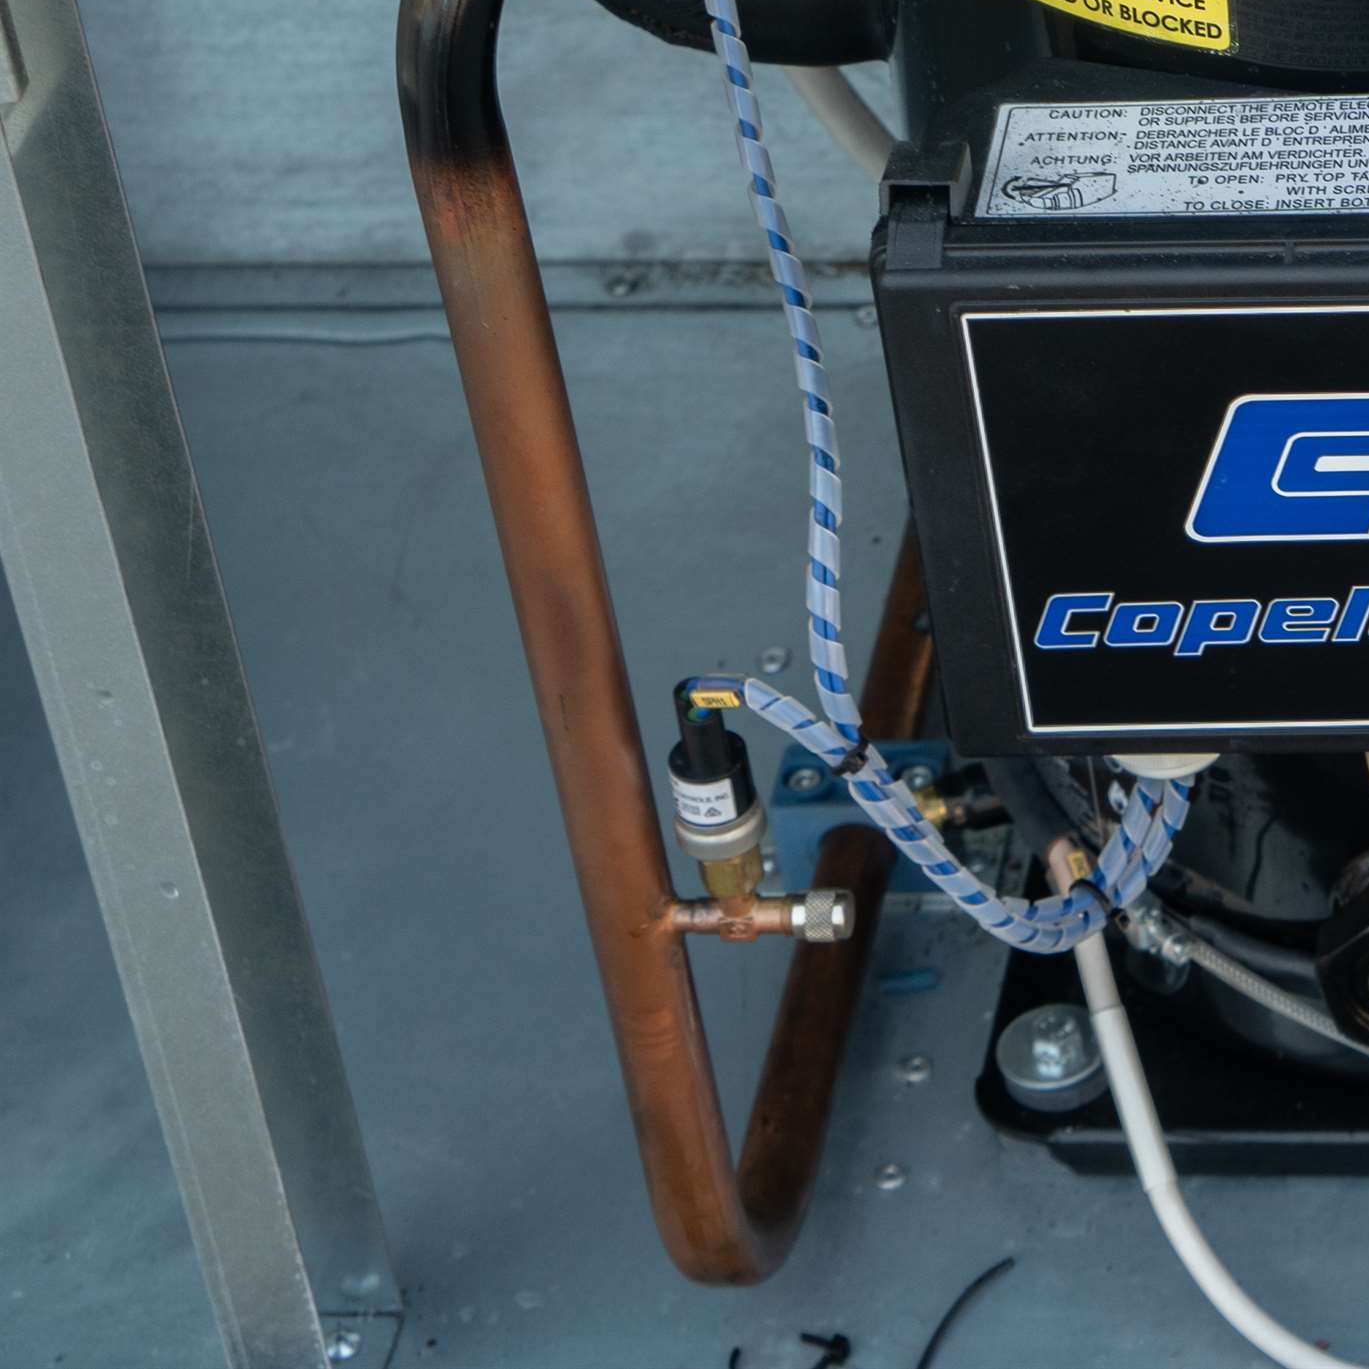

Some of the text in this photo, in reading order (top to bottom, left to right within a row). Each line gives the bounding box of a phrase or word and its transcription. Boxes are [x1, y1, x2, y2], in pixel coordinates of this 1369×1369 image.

[1120, 4, 1223, 40] BLOCKED
[1050, 109, 1127, 120] CAUTION:
[1140, 104, 1237, 117] DISCONNECT
[1242, 103, 1268, 113] THE
[1273, 101, 1336, 113] REMOTE
[1138, 117, 1161, 127] OR
[1164, 115, 1236, 126] SUPPLIES
[1239, 113, 1300, 124] BEFORE
[1136, 128, 1239, 140] DEBRANCHER
[1243, 127, 1264, 137] LE
[1267, 126, 1304, 136] BLOC
[1134, 138, 1207, 150] DISTANCE
[1210, 137, 1259, 148] AVANT
[1031, 155, 1118, 166] ACHTUNG:
[1129, 153, 1160, 164] VOR
[1163, 151, 1238, 163] ARBEITEN
[1241, 151, 1264, 161] AM
[1266, 149, 1366, 160] VERDICHTER.
[1127, 159, 1346, 174] SPANNUNGSZUFUEHRUNGEN
[1189, 175, 1209, 185] TO
[1214, 174, 1264, 185] OPEN:
[1314, 172, 1345, 182] TOP
[1286, 185, 1326, 196] WITH
[1184, 201, 1205, 211] TO
[1211, 199, 1269, 210] CLOSE:
[1276, 198, 1335, 209] INSERT
